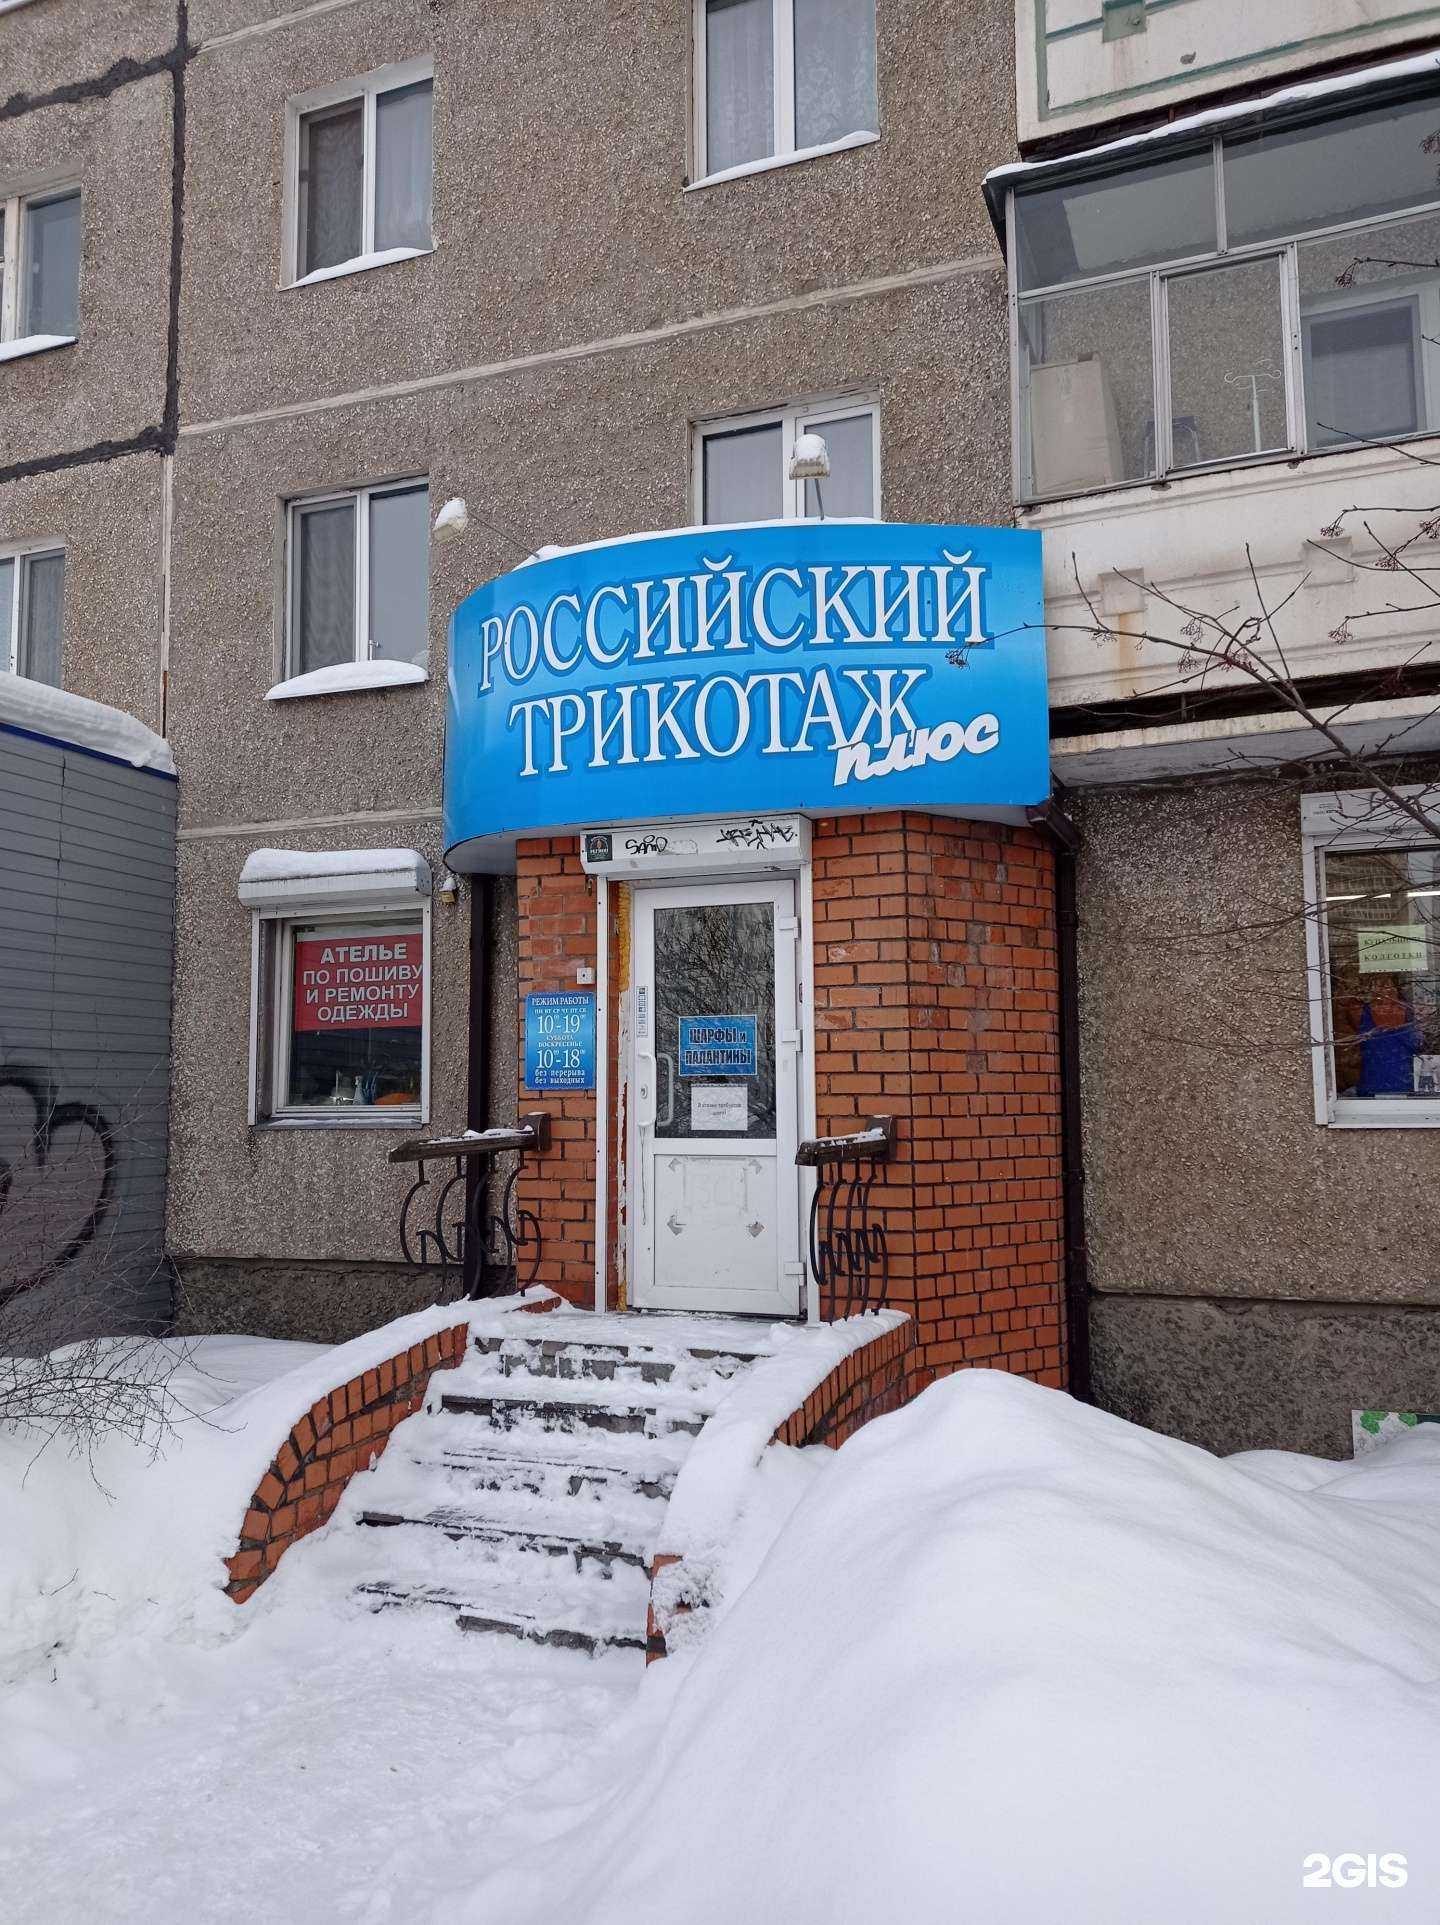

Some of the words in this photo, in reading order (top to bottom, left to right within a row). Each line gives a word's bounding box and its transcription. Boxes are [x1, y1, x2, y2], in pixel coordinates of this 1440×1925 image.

[478, 549, 987, 692] РОССИЙСКИЙ
[509, 668, 927, 777] ТРИКОТАЖ
[320, 943, 408, 964] АТЕЛЬЕ
[303, 970, 330, 985] ПО
[336, 964, 423, 984] ПОШИВУ
[306, 989, 319, 1004] И
[325, 983, 420, 1003] РЕМОНТУ
[531, 997, 559, 1006] РЕЖИМ
[560, 996, 589, 1005] РАБОТЫ
[317, 1003, 408, 1023] ОДЕЖДЫ
[685, 1048, 752, 1066] ПАЛАНТИНЫ
